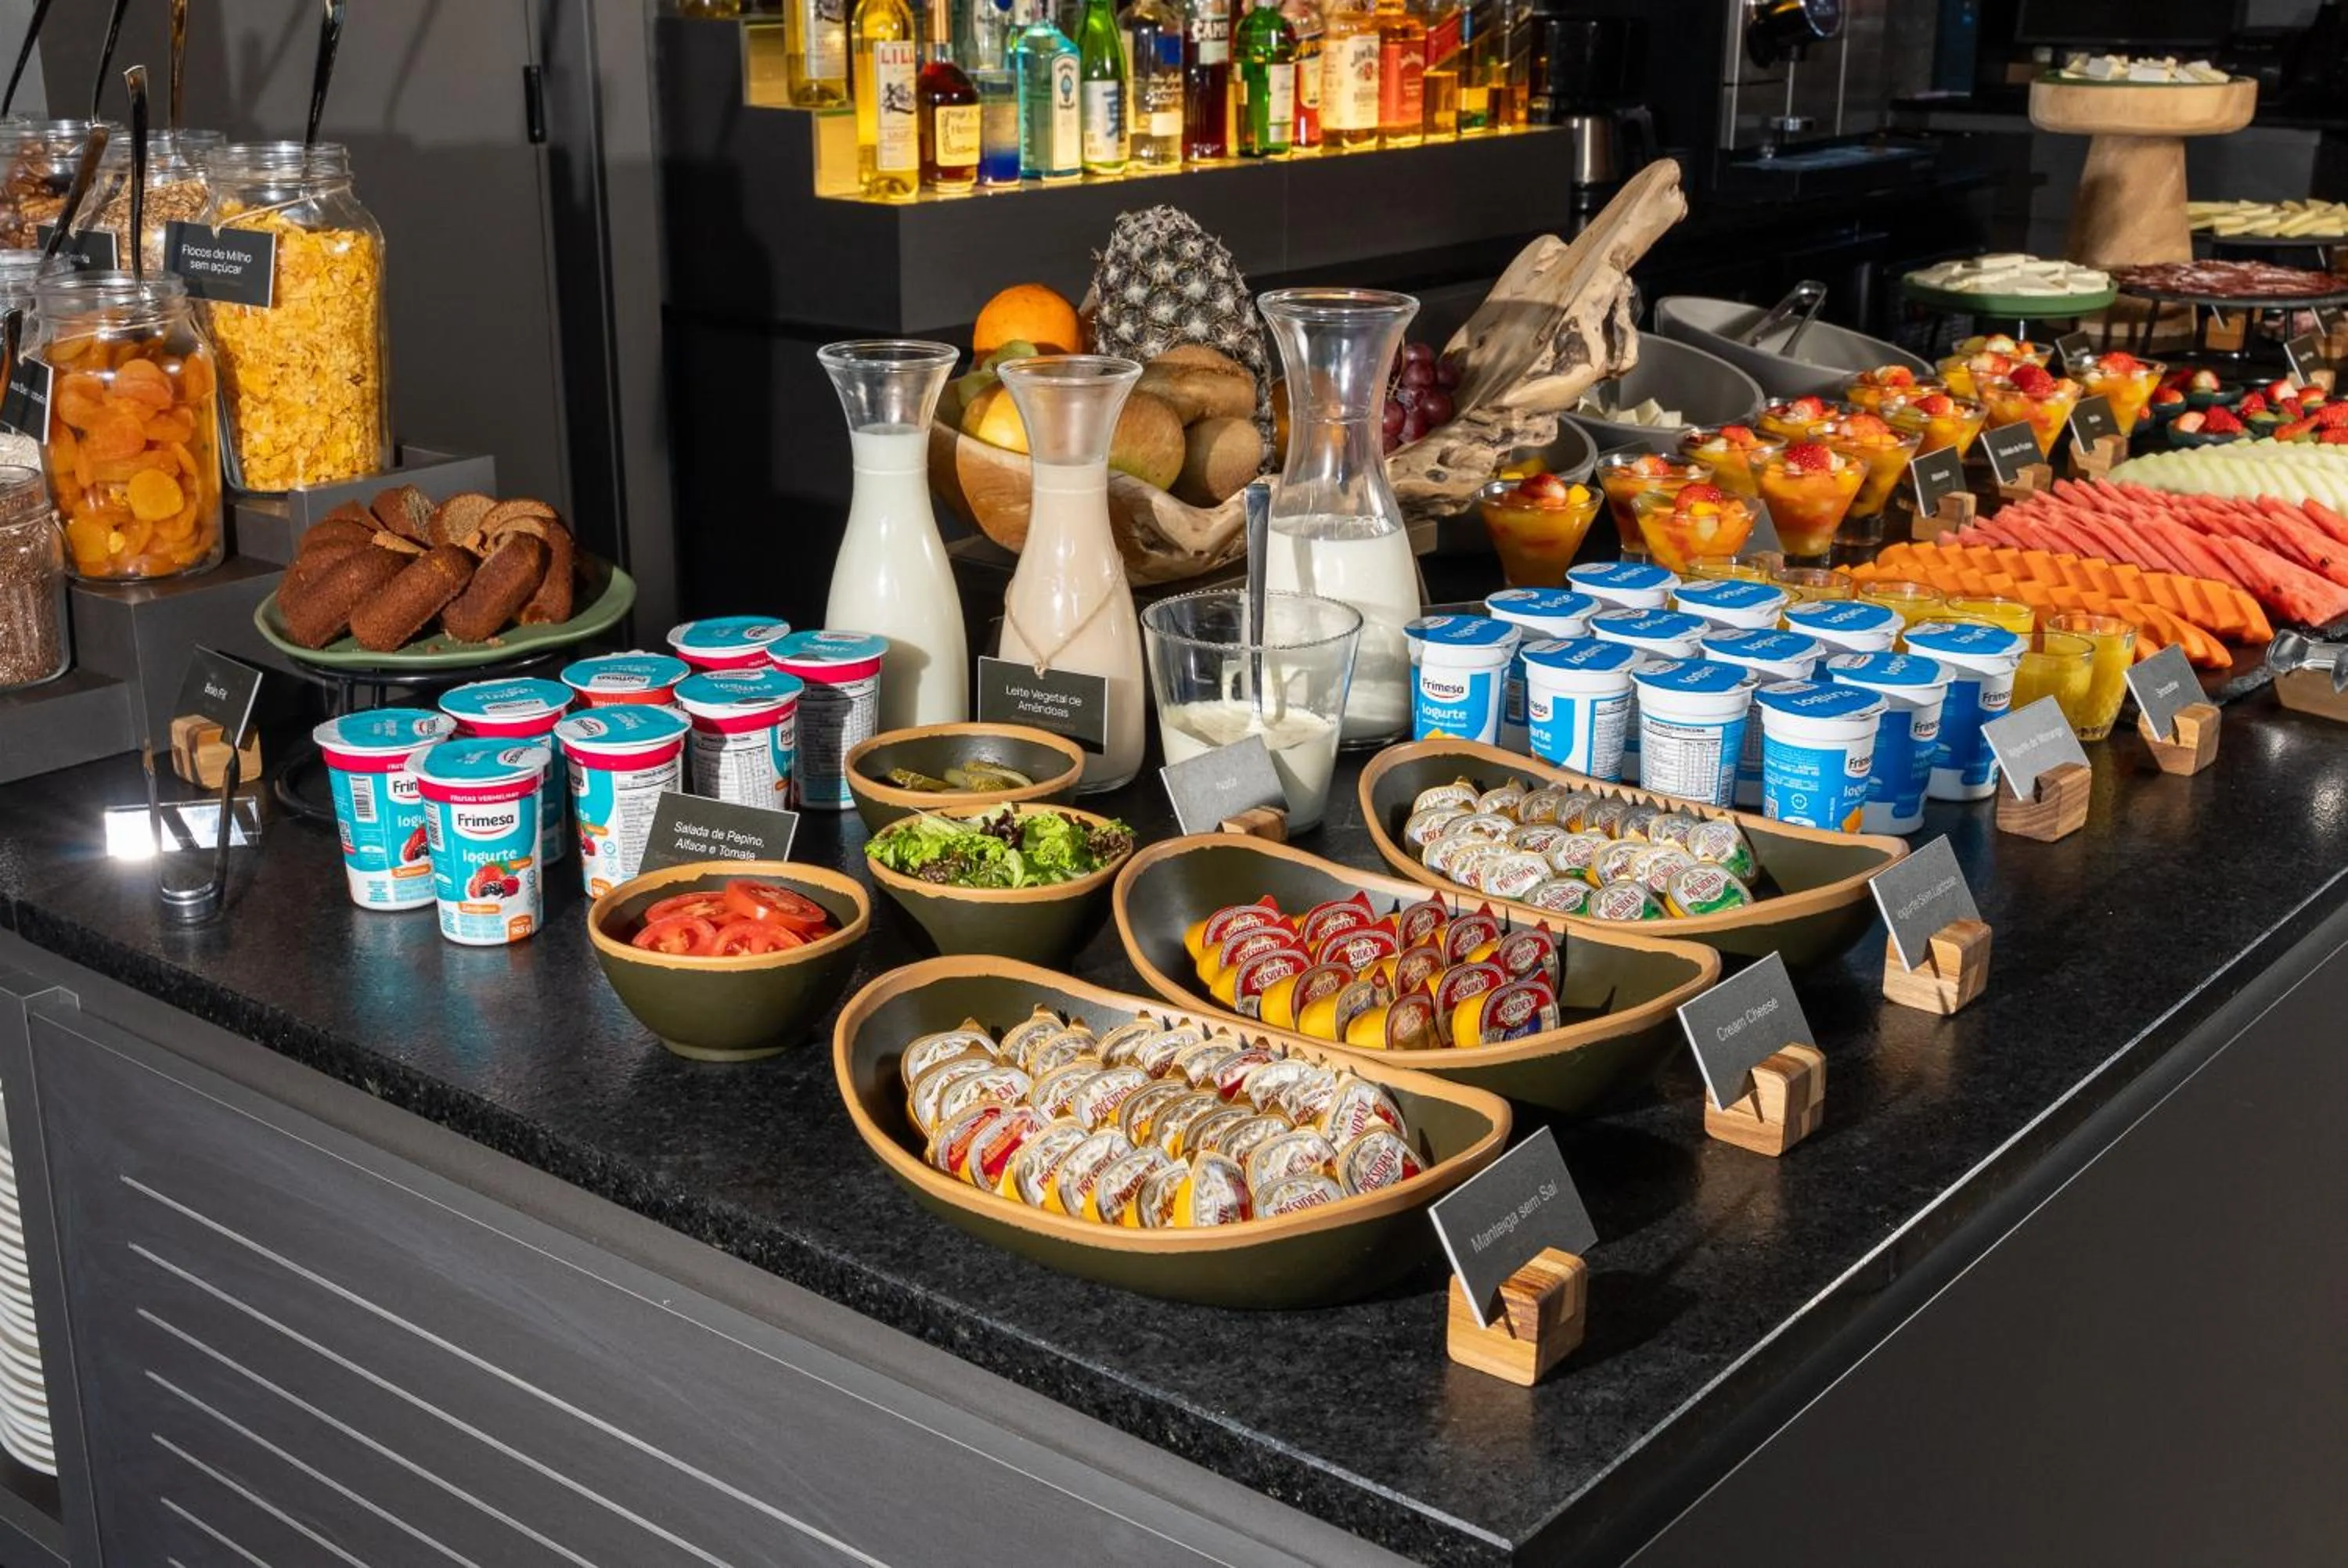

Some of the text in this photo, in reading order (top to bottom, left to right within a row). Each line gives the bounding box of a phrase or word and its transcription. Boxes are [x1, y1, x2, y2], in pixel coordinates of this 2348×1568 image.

[182, 243, 252, 263] Flocos de Milho
[190, 259, 210, 270] sem
[1422, 678, 1465, 694] Frimesa
[1006, 685, 1082, 707] Leite Vegetal de
[1017, 701, 1069, 718] Amêndoas
[1422, 703, 1468, 721] Iogurte
[457, 813, 514, 826] Frimesa
[674, 822, 765, 849] Salada de Pepino,
[463, 849, 517, 865] Iogurte
[675, 837, 756, 861] Alface e Tomate
[1716, 997, 1779, 1042] Cream Cheese
[1471, 1178, 1558, 1253] Manteiga sem Sal
